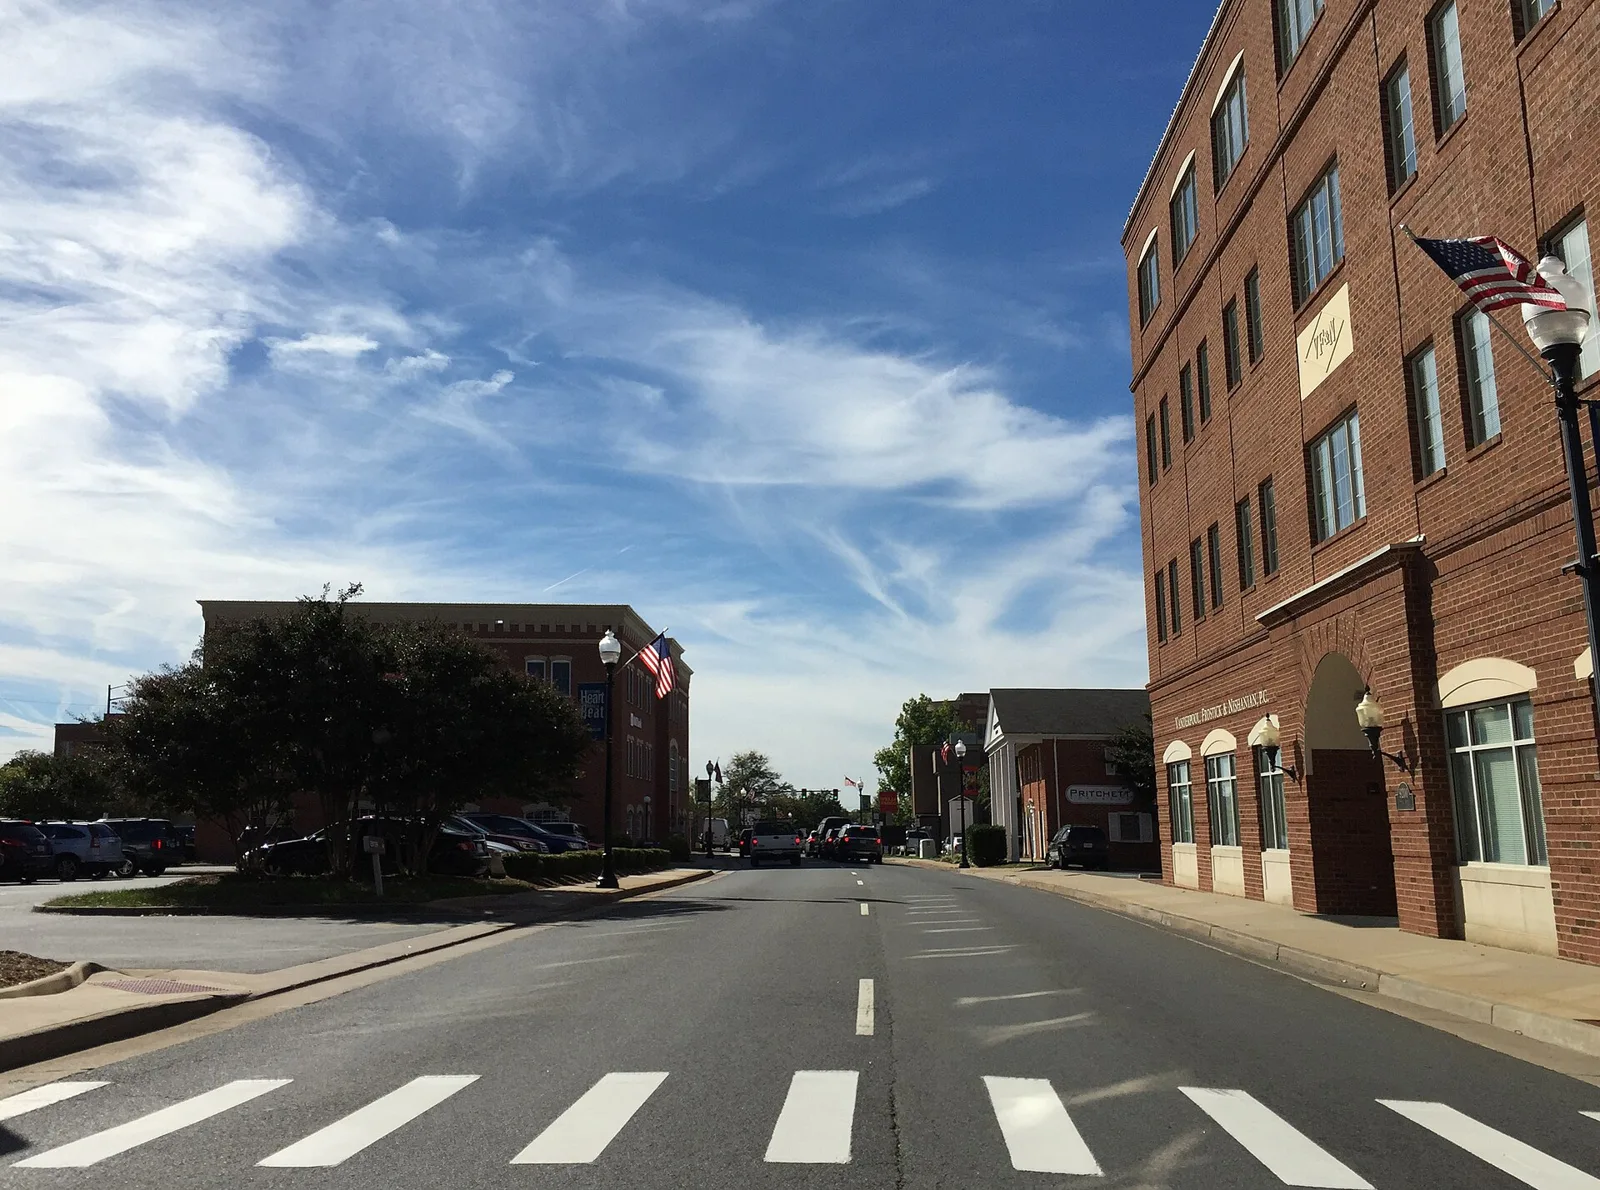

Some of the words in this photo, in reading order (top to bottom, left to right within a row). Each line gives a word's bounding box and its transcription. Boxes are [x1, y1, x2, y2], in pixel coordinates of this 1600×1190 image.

[580, 689, 605, 705] Heart
[580, 704, 604, 719] Beat
[1222, 703, 1228, 716] &
